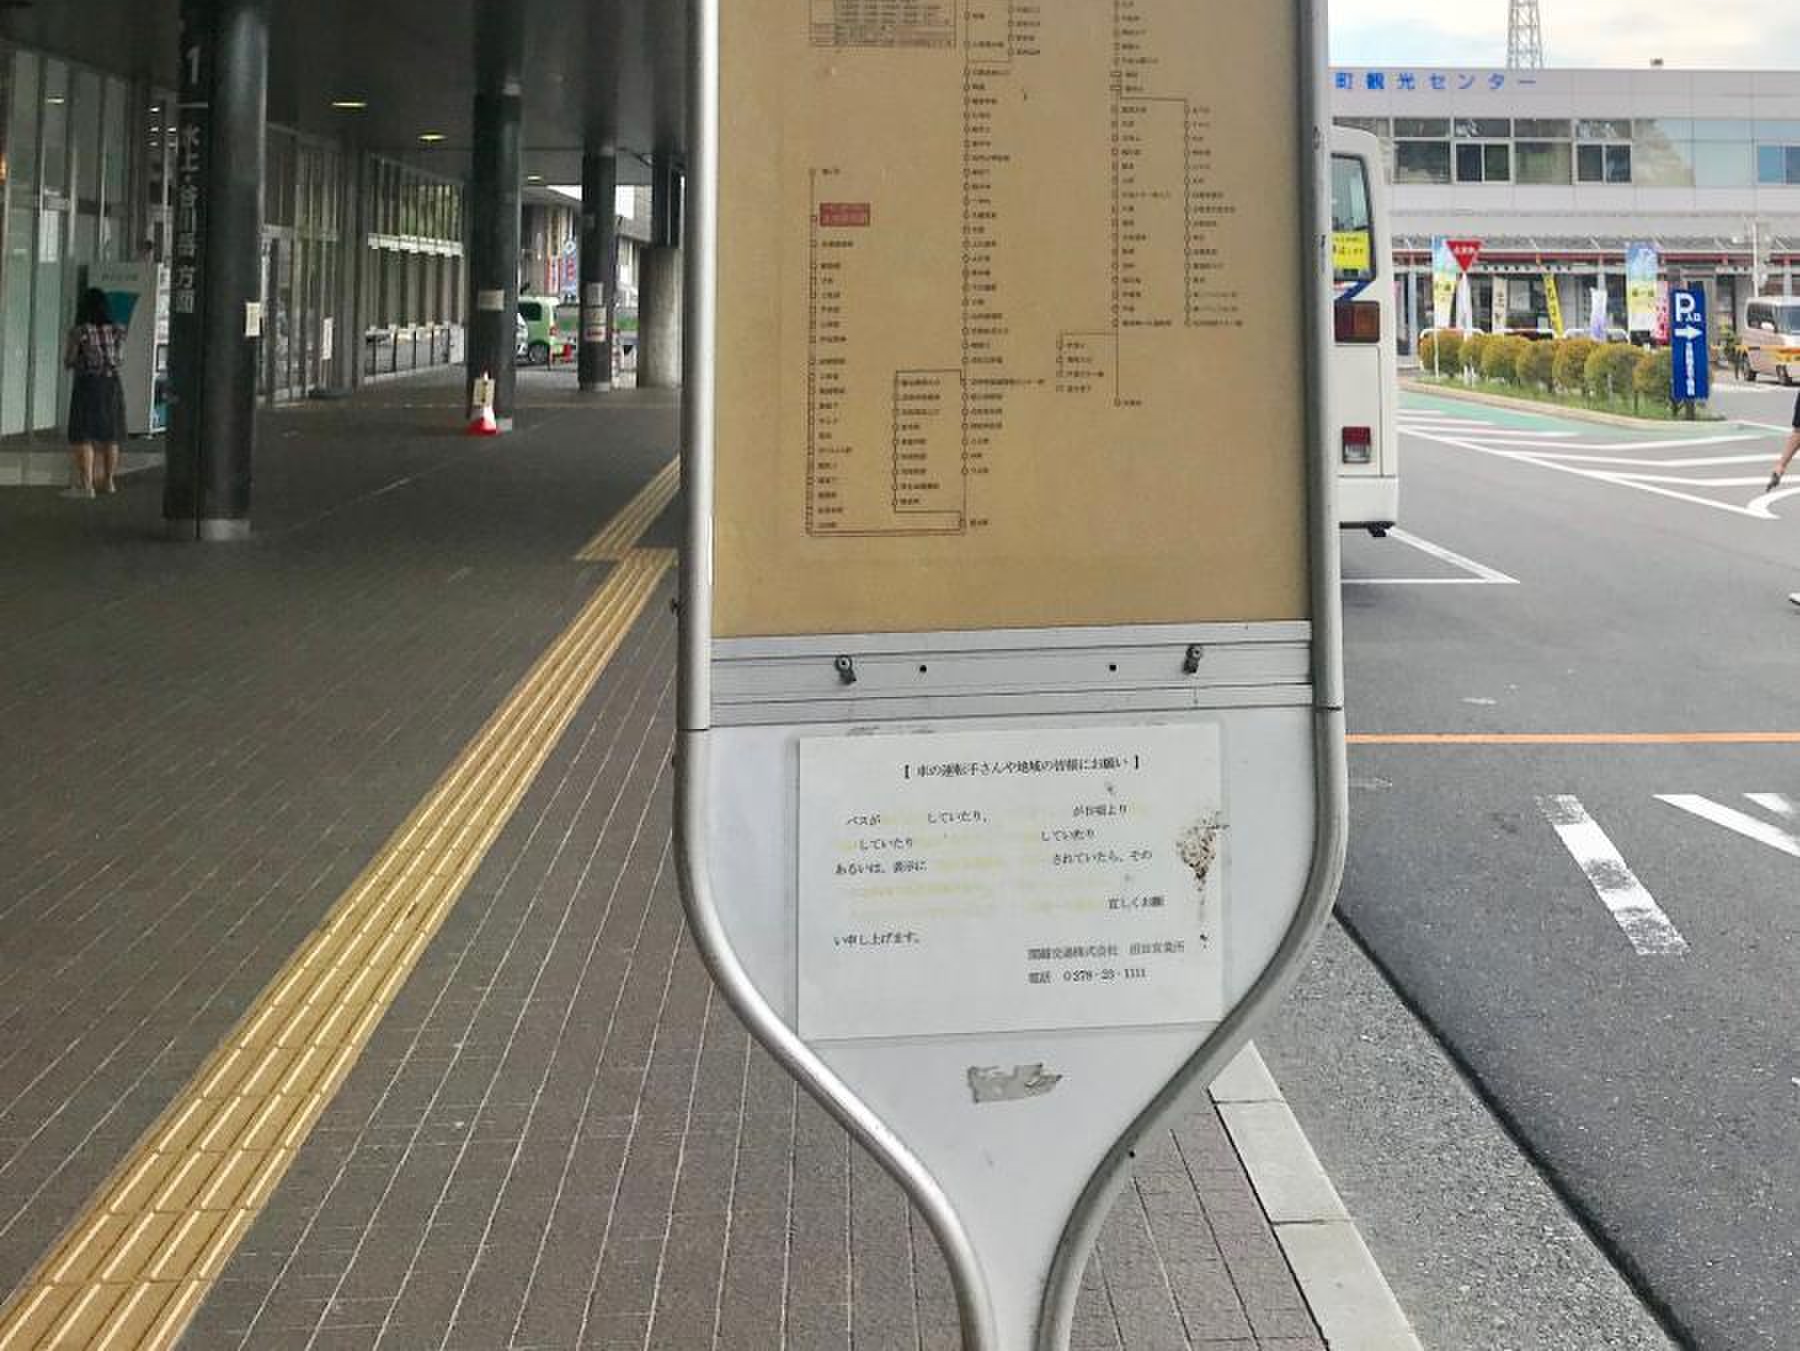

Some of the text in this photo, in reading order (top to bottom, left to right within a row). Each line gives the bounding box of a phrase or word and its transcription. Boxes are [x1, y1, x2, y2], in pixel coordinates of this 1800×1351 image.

[1334, 72, 1537, 90] 町観光センター
[1675, 292, 1696, 322] P
